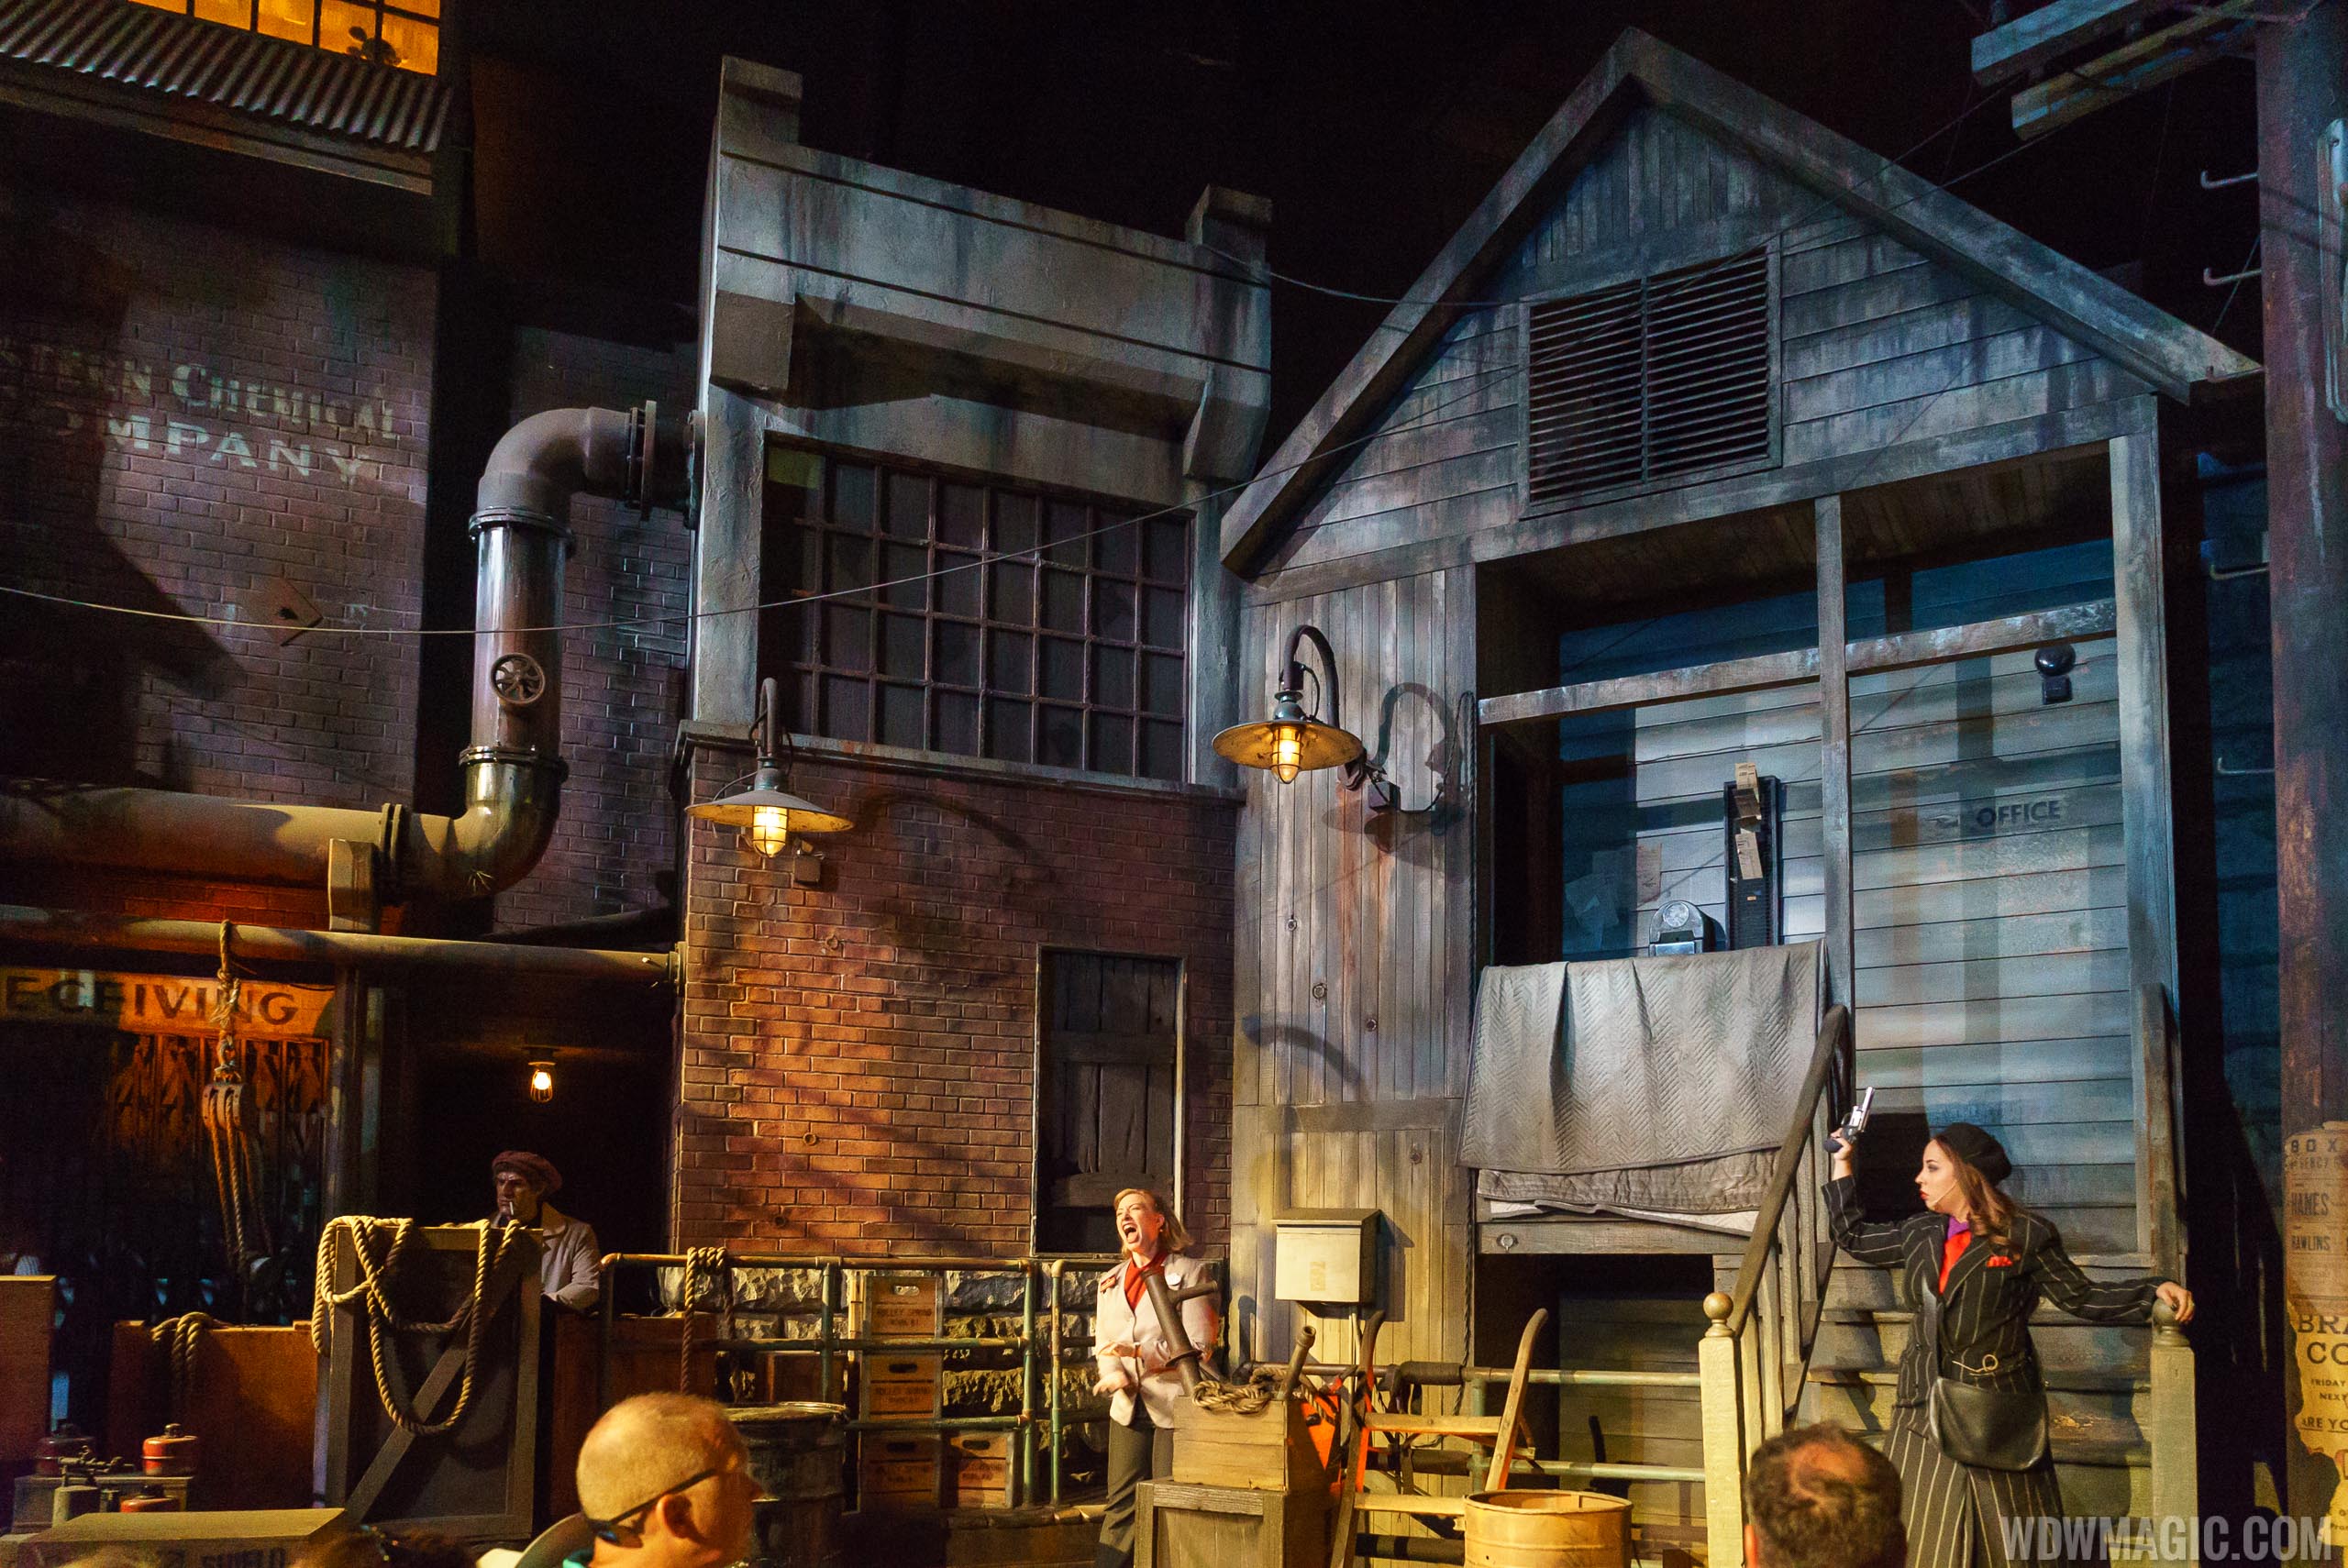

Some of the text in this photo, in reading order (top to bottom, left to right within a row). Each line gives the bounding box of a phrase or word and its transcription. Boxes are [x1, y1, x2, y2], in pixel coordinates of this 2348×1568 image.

[172, 363, 398, 439] CHEMICAL
[1977, 799, 2061, 827] OFFICE
[2298, 1313, 2348, 1334] BR
